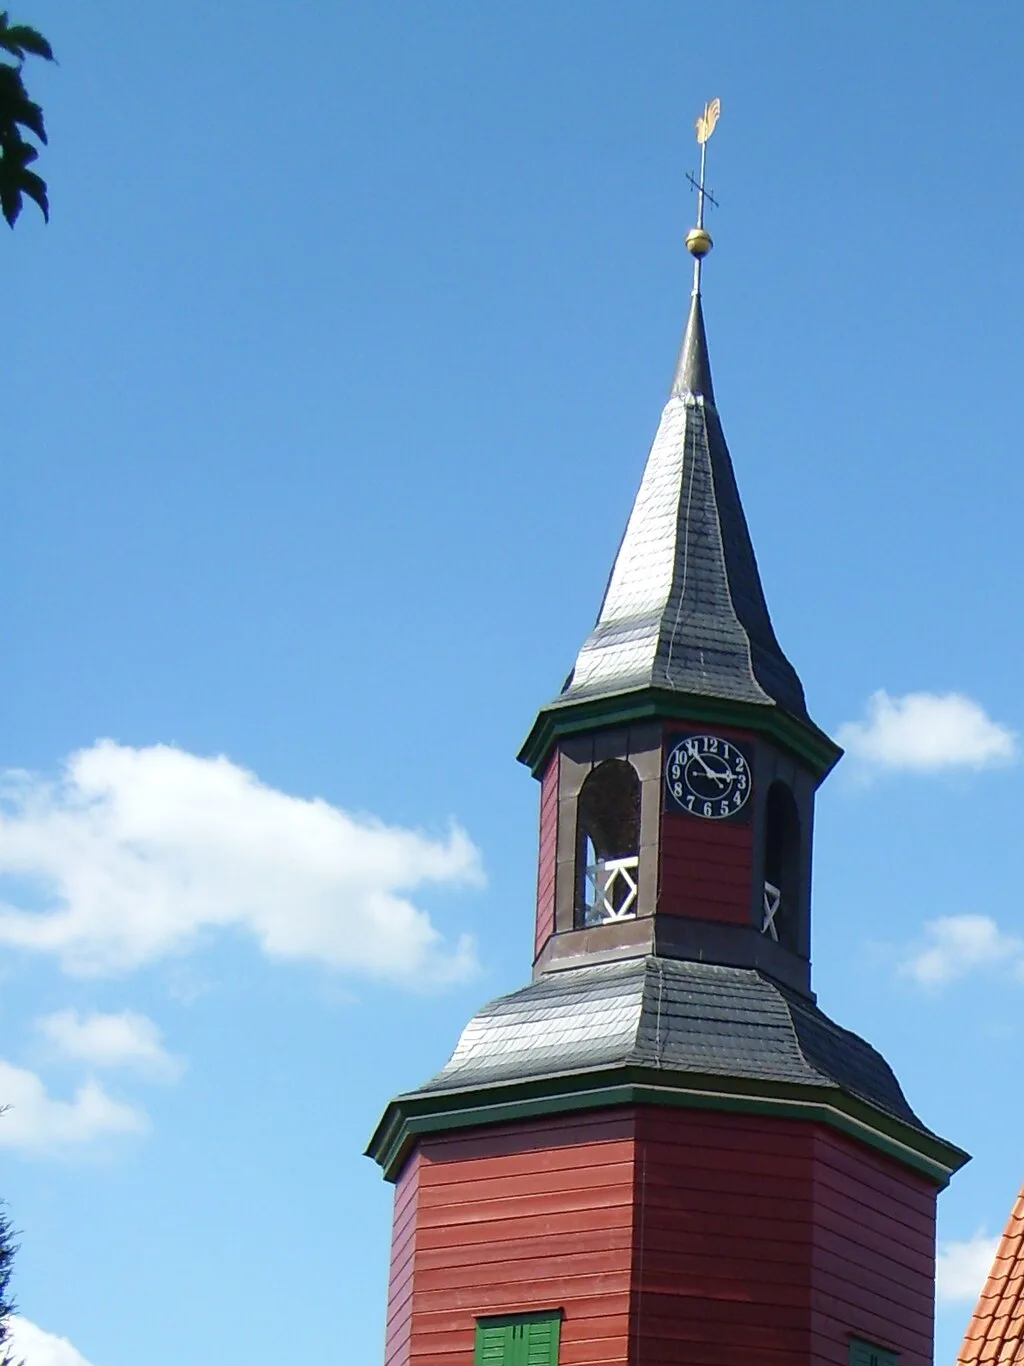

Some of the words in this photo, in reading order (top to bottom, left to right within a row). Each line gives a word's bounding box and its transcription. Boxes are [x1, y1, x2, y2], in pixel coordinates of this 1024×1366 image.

[703, 737, 718, 753] 12
[724, 744, 729, 759] 1
[674, 750, 687, 765] 10
[736, 757, 744, 772] 2
[672, 764, 681, 779] 9
[737, 774, 746, 789] 3
[674, 782, 682, 797] 8
[686, 795, 695, 810] 7
[733, 790, 741, 805] 4
[703, 802, 712, 817] 6
[720, 800, 729, 815] 5
